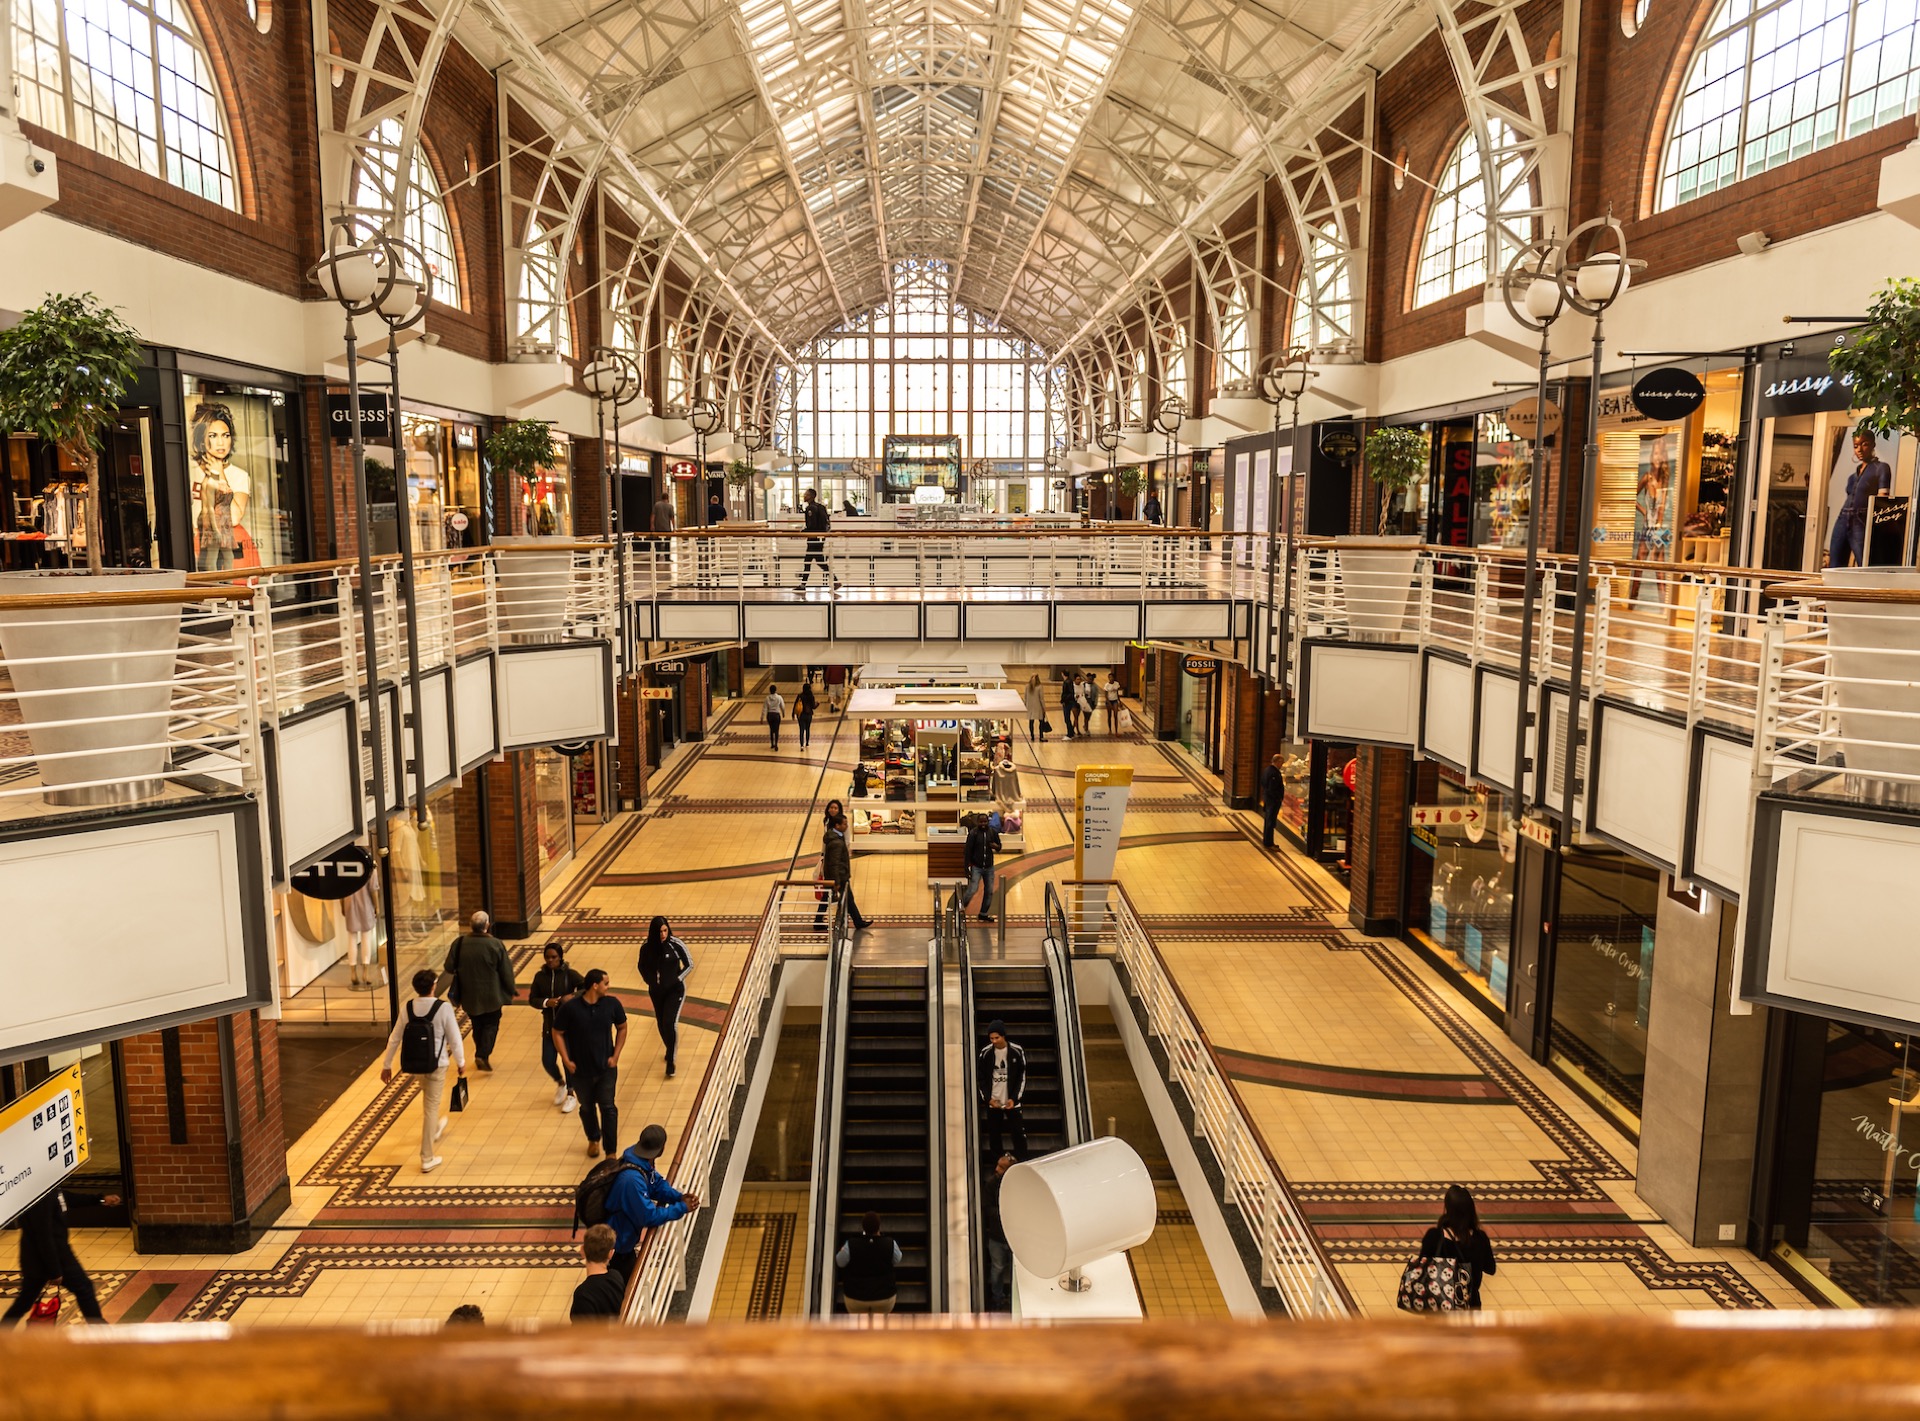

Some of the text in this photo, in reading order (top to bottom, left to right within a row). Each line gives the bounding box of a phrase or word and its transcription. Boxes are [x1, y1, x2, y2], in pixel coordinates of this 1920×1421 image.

[1764, 375, 1834, 398] sissy
[1639, 389, 1698, 399] sissy boy
[332, 409, 386, 422] GUESS
[1510, 413, 1558, 421] SEAFLLY
[707, 471, 726, 479] VANS
[1451, 449, 1472, 547] SALE
[453, 517, 467, 525] sale
[1875, 513, 1902, 524] boy
[242, 538, 264, 549] GUESS
[655, 660, 684, 672] rain
[1589, 934, 1649, 980] Master Origin
[1851, 1115, 1909, 1156] Master
[0, 1166, 32, 1196] Cinema
